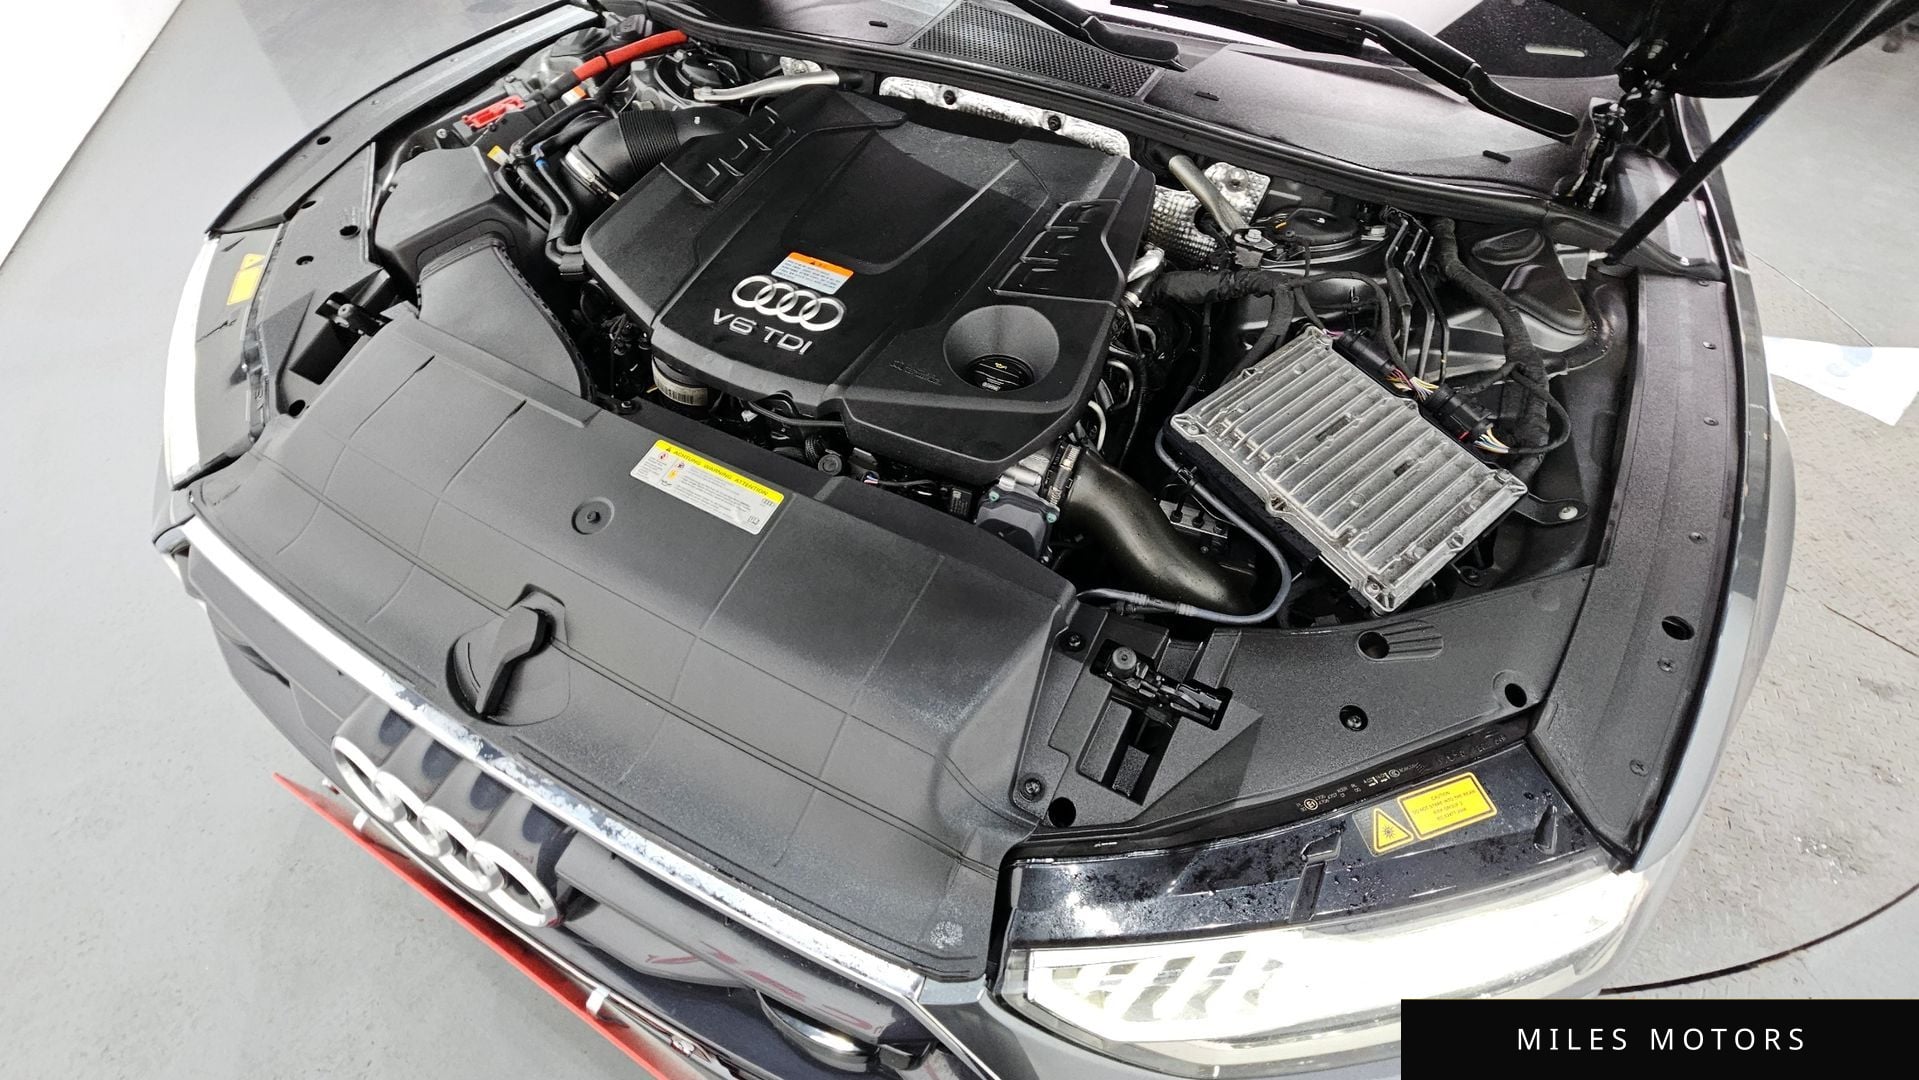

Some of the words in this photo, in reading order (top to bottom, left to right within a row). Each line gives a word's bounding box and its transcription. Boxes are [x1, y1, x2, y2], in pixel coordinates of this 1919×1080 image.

[713, 308, 757, 335] V6
[763, 325, 813, 355] TDI
[673, 450, 701, 467] ACHTUNG
[703, 463, 732, 481] WARNING
[734, 478, 769, 497] ATTENTION
